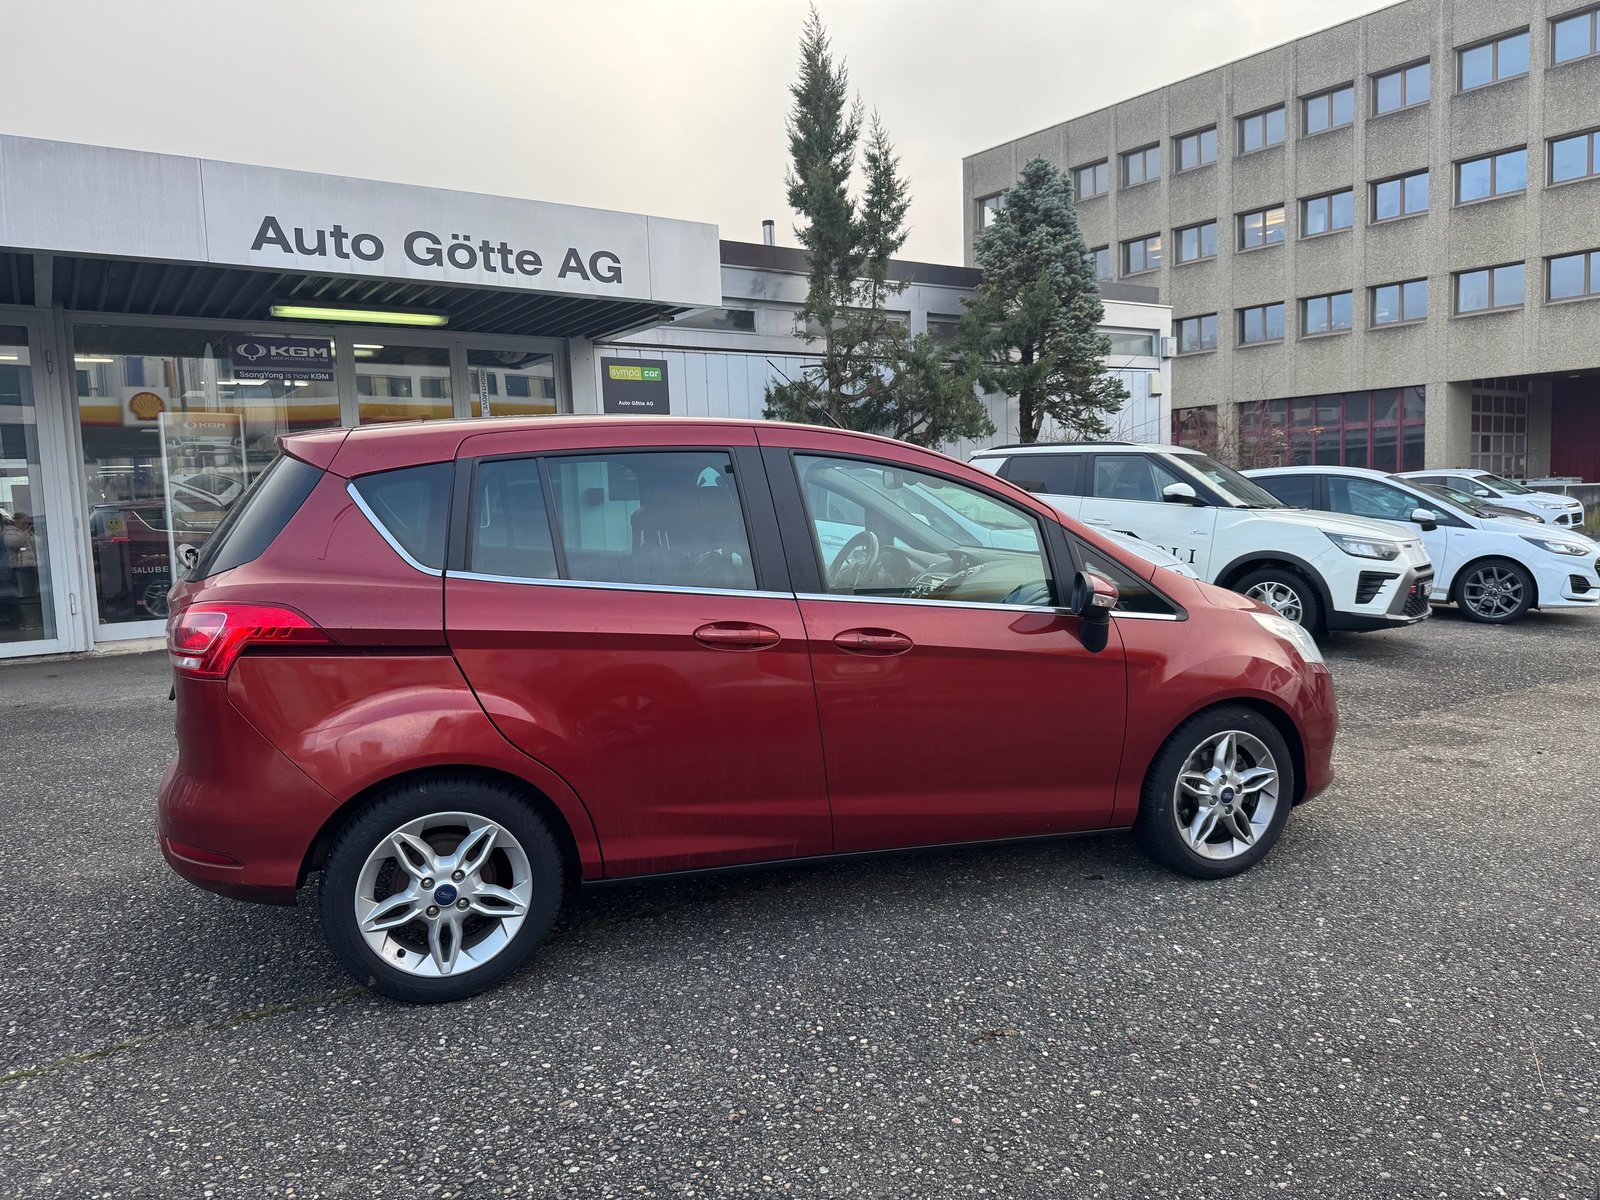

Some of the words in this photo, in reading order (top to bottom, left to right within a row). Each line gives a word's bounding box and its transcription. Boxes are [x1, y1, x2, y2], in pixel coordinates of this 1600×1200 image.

[250, 215, 384, 262] Auto
[403, 230, 543, 276] Götte
[557, 247, 622, 284] AG
[270, 346, 328, 357] KGM
[239, 371, 284, 380] SsangYong
[611, 368, 640, 379] sympa
